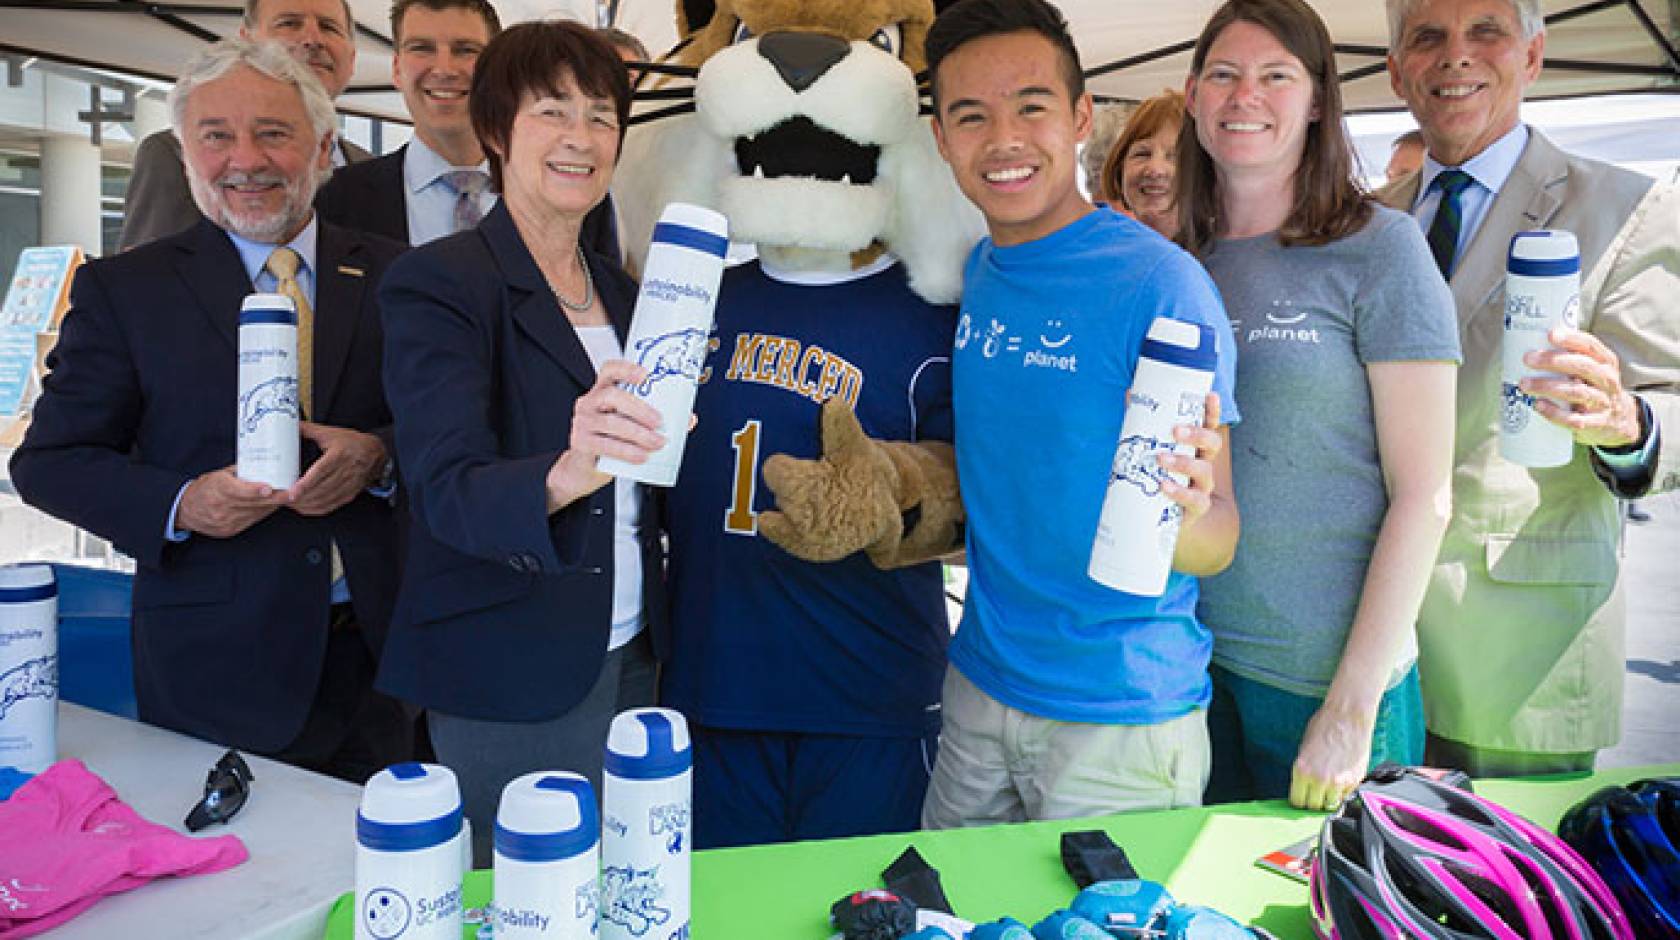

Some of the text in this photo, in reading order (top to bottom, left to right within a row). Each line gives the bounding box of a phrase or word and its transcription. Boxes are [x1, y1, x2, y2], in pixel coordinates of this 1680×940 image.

[1246, 325, 1321, 344] planet
[724, 332, 863, 411] MERCED
[1023, 349, 1078, 373] planet
[724, 419, 762, 537] 1
